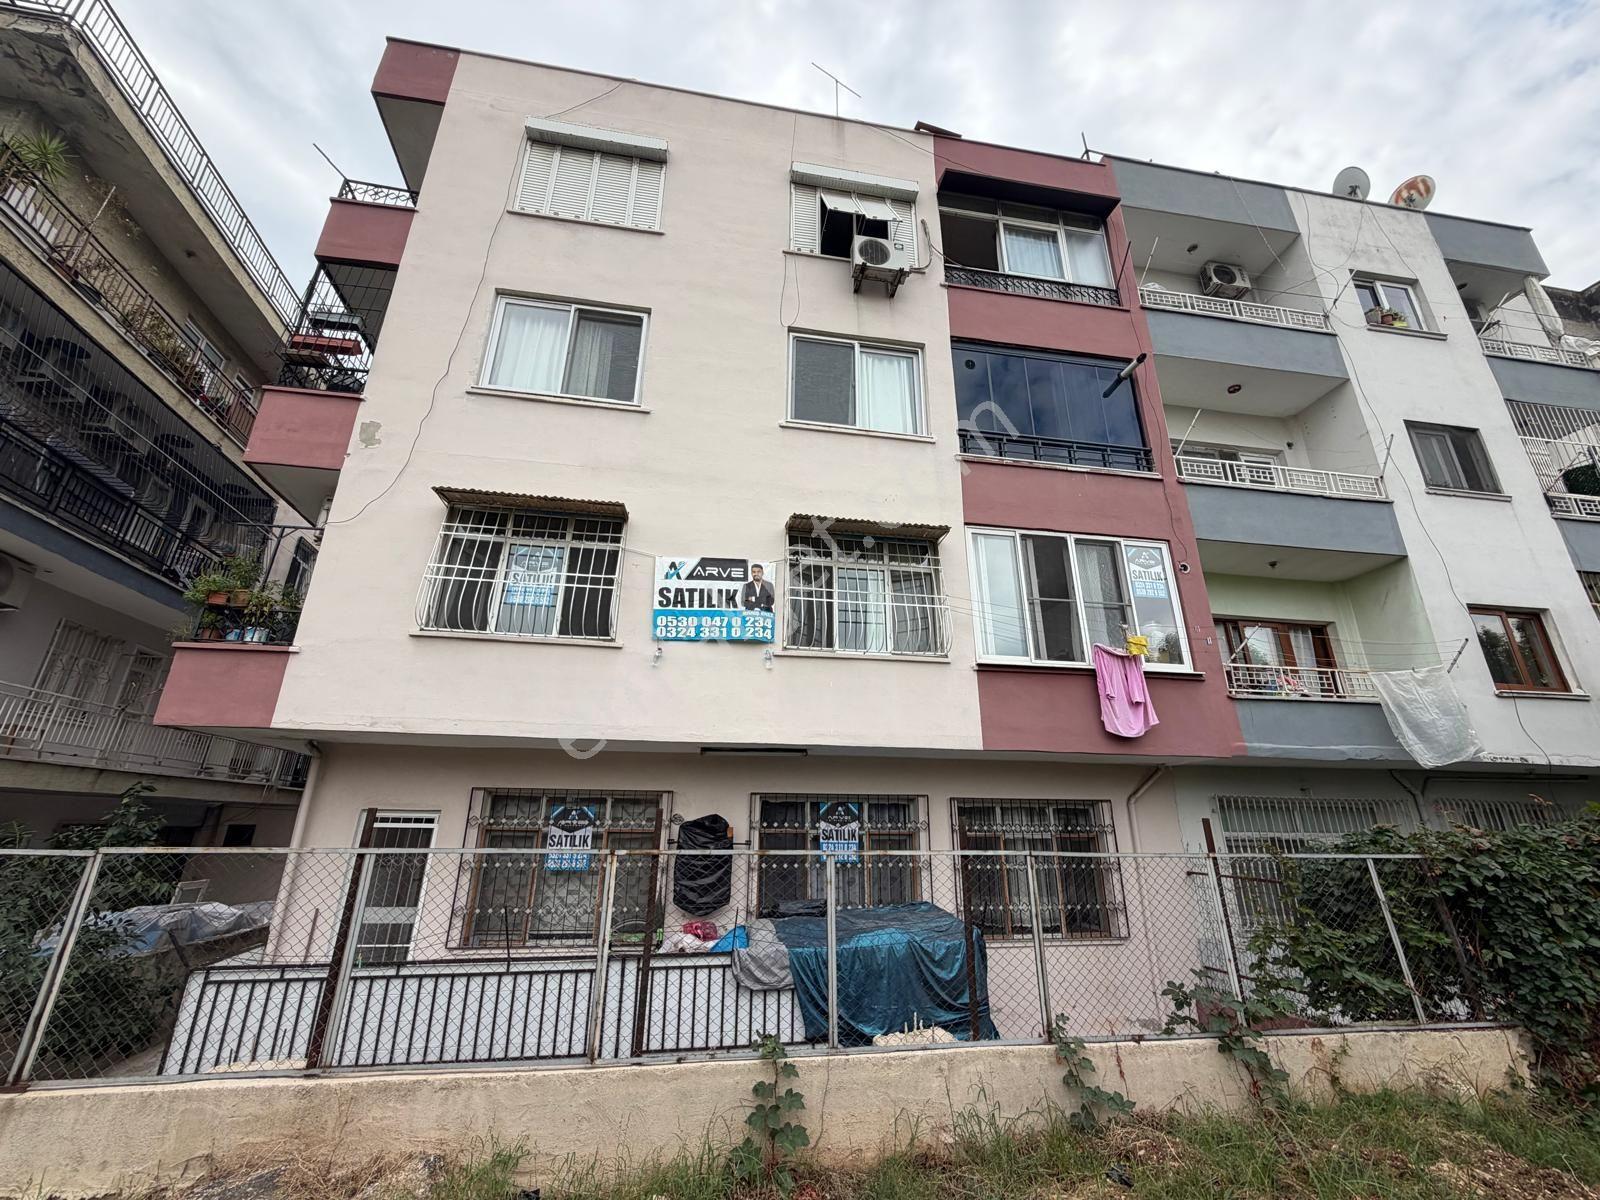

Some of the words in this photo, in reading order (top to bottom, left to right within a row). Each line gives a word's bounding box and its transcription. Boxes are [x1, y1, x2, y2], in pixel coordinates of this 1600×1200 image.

[693, 566, 745, 578] ARVE
[1132, 569, 1163, 581] SATILIK
[658, 586, 739, 609] SATILIK
[656, 616, 698, 628] 0530
[701, 616, 729, 627] 047
[731, 616, 741, 627] 0
[745, 616, 772, 629] 234
[656, 627, 696, 638] 0324
[700, 627, 727, 638] 331
[731, 627, 741, 638] 0
[744, 627, 772, 640] 234
[549, 834, 590, 848] SATILIK
[822, 828, 857, 841] SATILIK
